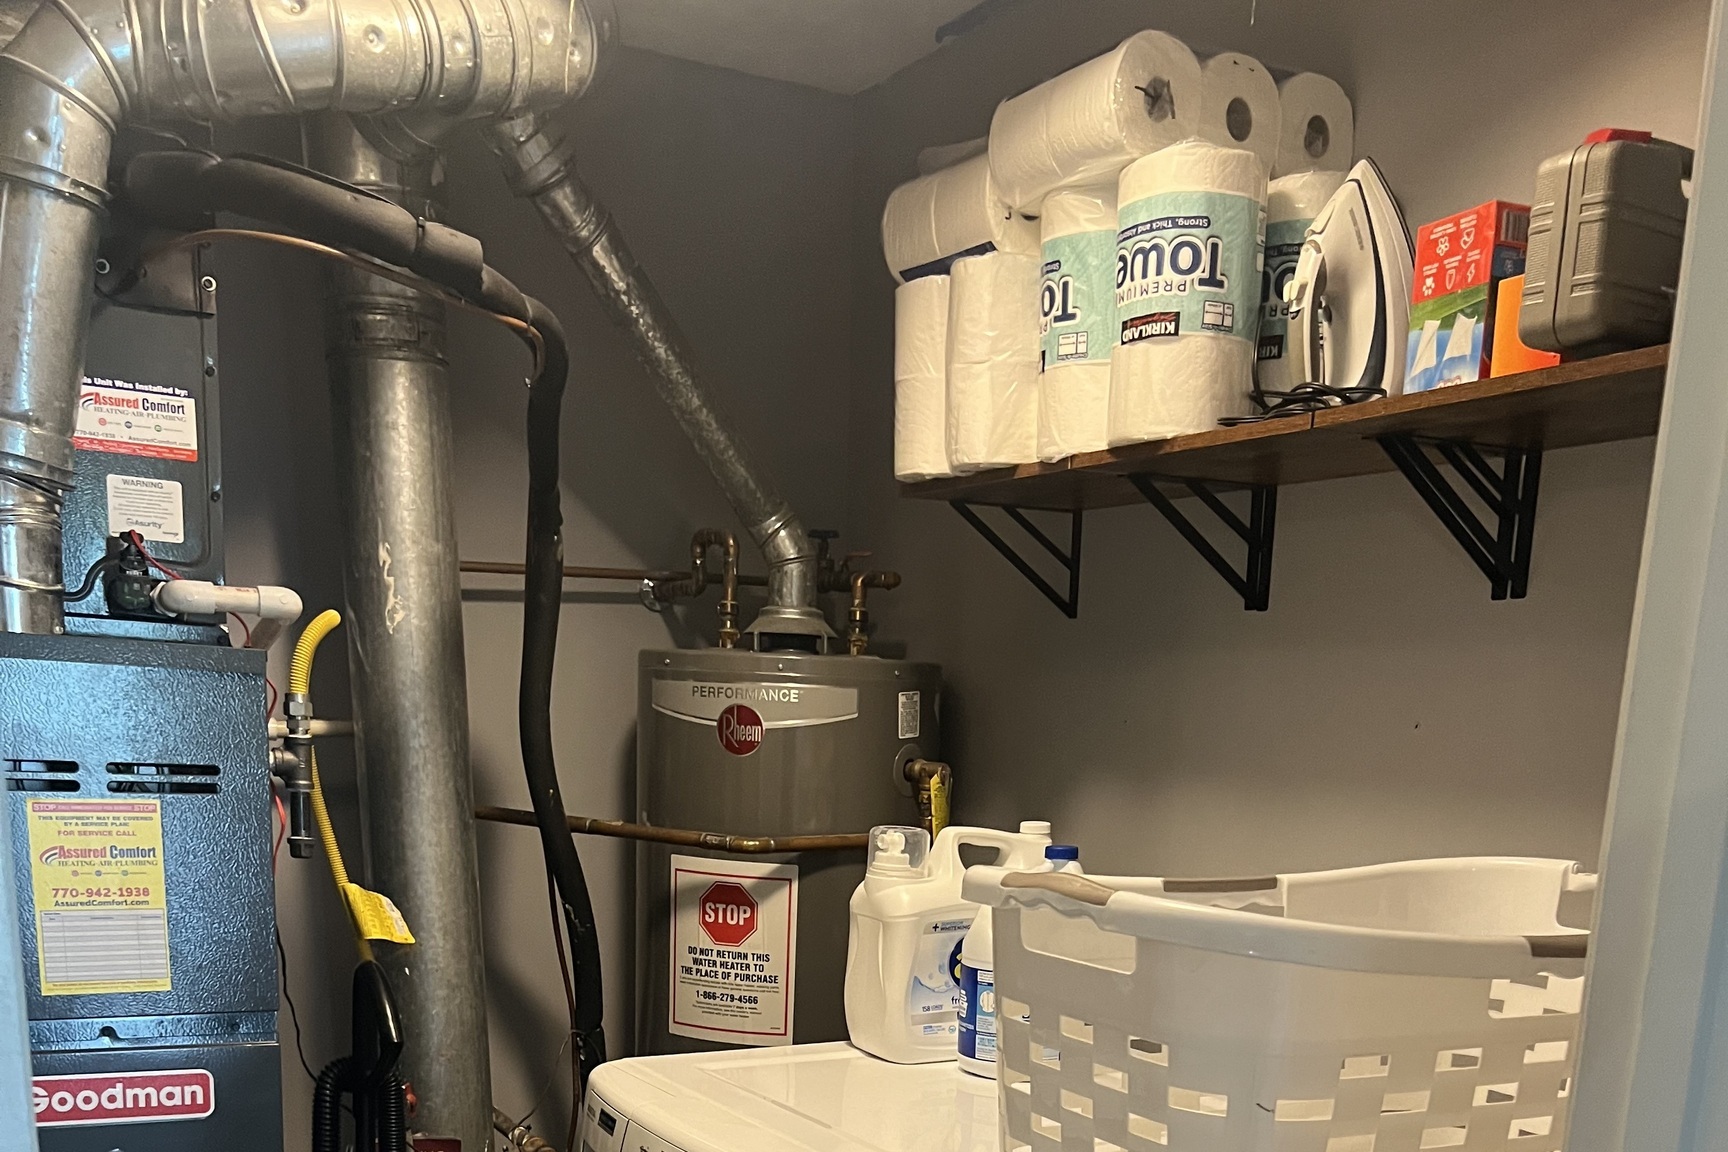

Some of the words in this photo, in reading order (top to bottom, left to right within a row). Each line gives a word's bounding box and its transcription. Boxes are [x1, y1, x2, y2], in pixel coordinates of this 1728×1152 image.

[1123, 321, 1176, 342] KIRKLAND
[94, 378, 113, 387] Unit
[115, 380, 134, 390] Was
[135, 382, 174, 394] Installed
[93, 392, 139, 409] Assured
[142, 398, 186, 416] Comfort
[121, 478, 164, 490] WARNING
[692, 686, 799, 703] PERFORMANCE
[723, 705, 761, 748] Rheem
[33, 804, 57, 812] STOP
[134, 804, 157, 812] STOP
[57, 845, 107, 860] Assured
[110, 845, 157, 860] Comfort
[52, 887, 150, 899] 770-942-1938
[54, 900, 150, 908] AssuredComfort.com
[705, 902, 751, 926] STOP
[688, 946, 698, 956] DO
[699, 947, 715, 958] NOT
[716, 950, 749, 962] RETURN
[751, 953, 771, 963] THIS
[692, 957, 718, 970] WATER
[720, 960, 751, 972] HEATER
[754, 964, 765, 973] TO
[681, 966, 694, 976] THE
[696, 967, 720, 980] PLACE
[721, 971, 733, 981] OF
[734, 972, 779, 985] PURCHASE
[696, 990, 759, 1005] 1-866-279-4566
[32, 1082, 204, 1114] Goodman
